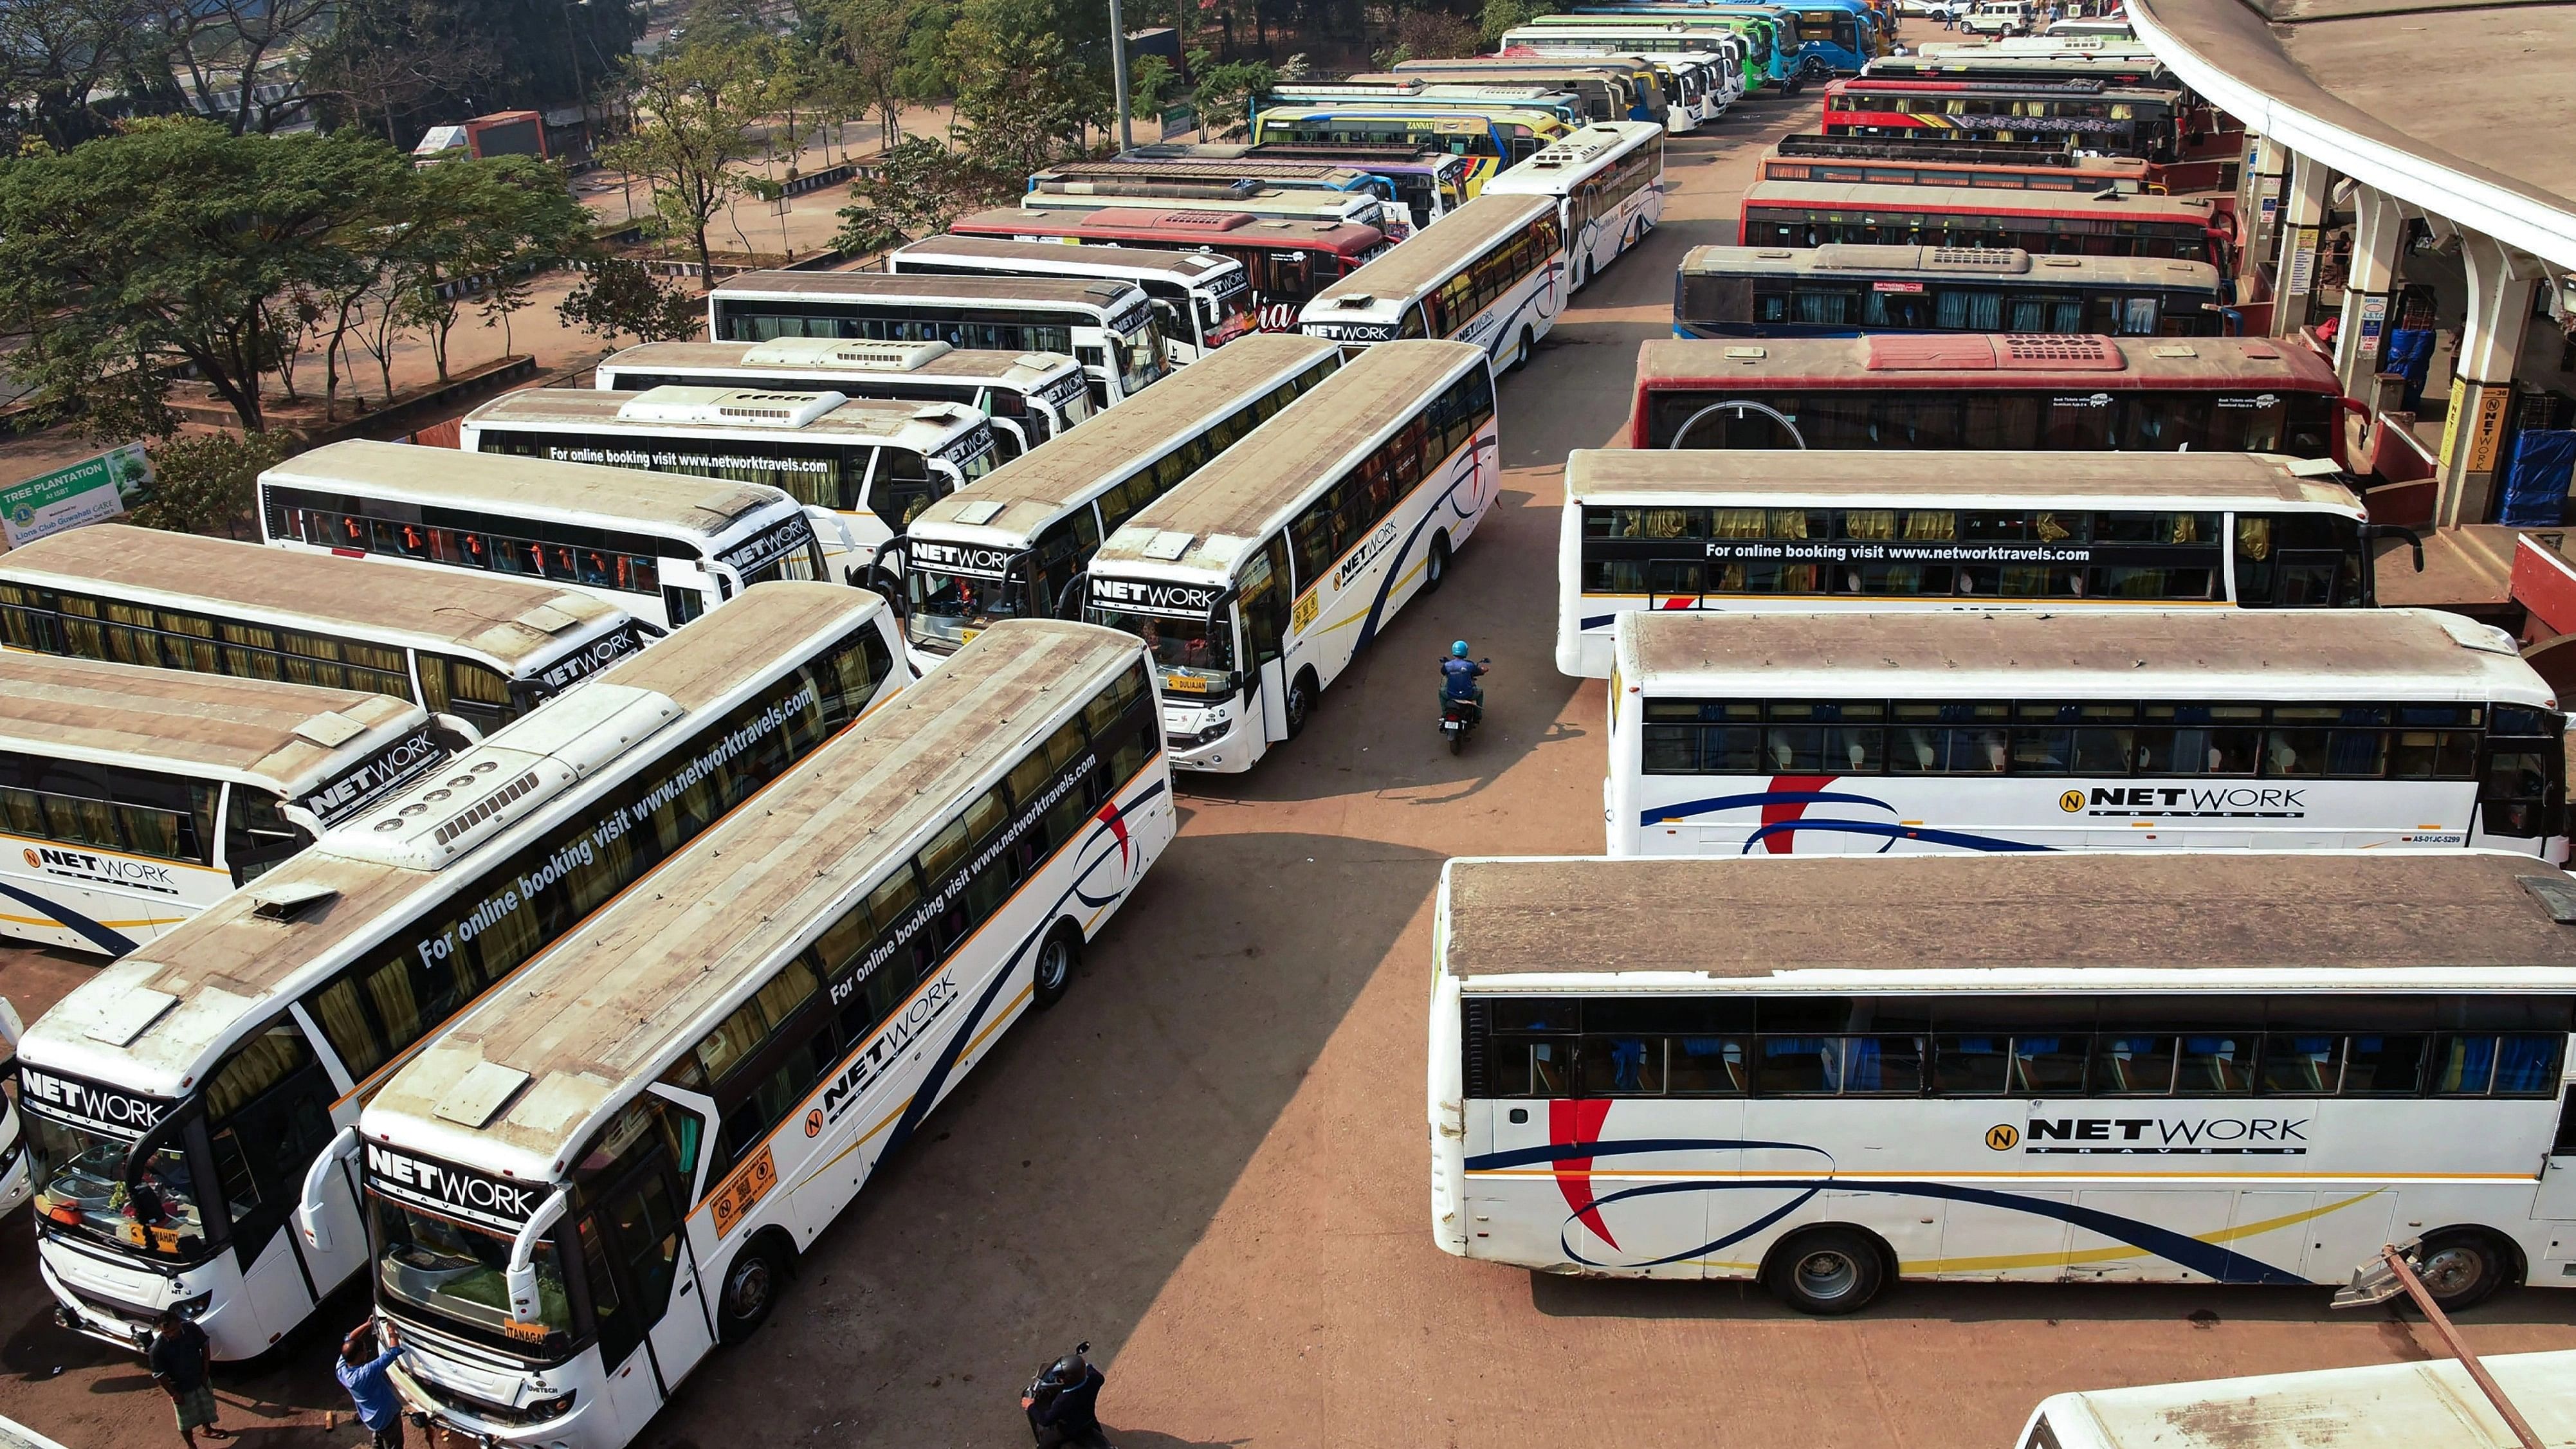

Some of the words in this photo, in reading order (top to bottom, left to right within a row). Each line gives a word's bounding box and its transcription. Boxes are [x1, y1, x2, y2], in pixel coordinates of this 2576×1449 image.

[1302, 324, 1389, 341] NETWORK
[2476, 412, 2497, 469] NETWORK
[551, 446, 568, 460] For
[571, 448, 604, 462] online
[607, 450, 650, 468] booking
[652, 451, 677, 466] visit
[679, 455, 828, 473] www.networktravels.com
[3, 487, 32, 504] TREE
[34, 463, 103, 494] PLANTATION
[15, 529, 38, 541] Lions
[39, 521, 57, 532] Club
[57, 508, 92, 526] Guwahati
[911, 542, 1016, 569] NETWORK
[1340, 516, 1398, 579] NETWORK
[1706, 543, 1729, 557] For
[1735, 543, 1782, 558] online
[1785, 544, 1847, 561] booking
[1850, 545, 1884, 559] visit
[1888, 546, 2090, 561] www.networktravels.com
[1093, 579, 1216, 607] NETWORK
[1179, 680, 1206, 689] DULIAJAN
[309, 729, 435, 816] NETWORK
[2090, 787, 2308, 811] NETWORK
[418, 931, 454, 969] For
[459, 891, 518, 942] online
[517, 839, 594, 900] booking
[592, 808, 632, 849] visit
[632, 686, 814, 822] www.networktravels.com
[39, 848, 175, 885] NETWORK
[830, 976, 854, 1006] For
[856, 939, 895, 981] online
[895, 893, 945, 945] booking
[944, 870, 971, 900] visit
[971, 753, 1096, 875] www.networktravels.com
[823, 967, 956, 1113] NETWORK
[22, 1067, 164, 1127] NETWORK
[28, 1100, 136, 1137] TRAVEL
[2027, 1118, 2311, 1145] NETWORK
[368, 1144, 534, 1216] NETWORK
[506, 1326, 546, 1345] ITANAGA
